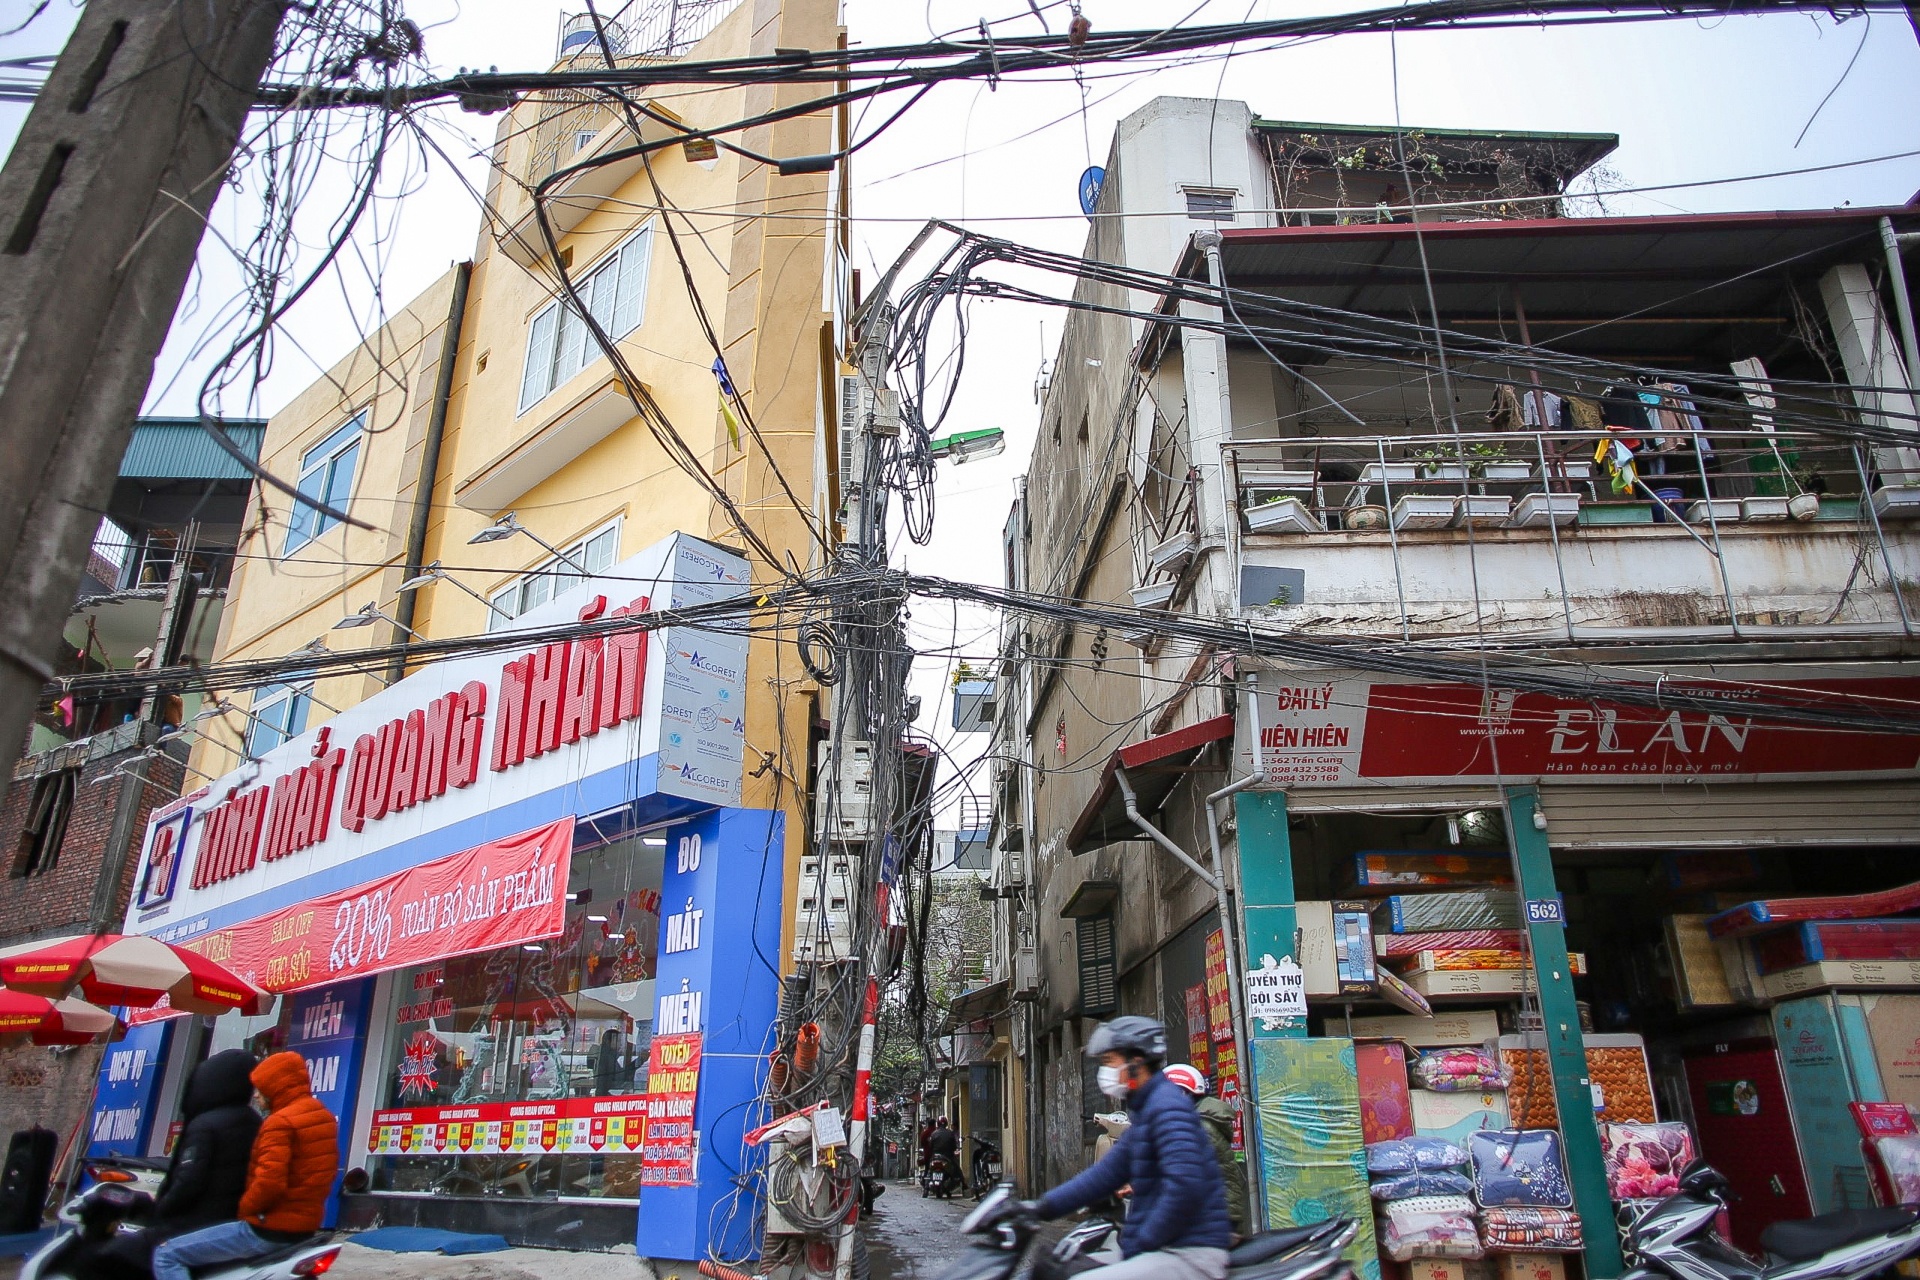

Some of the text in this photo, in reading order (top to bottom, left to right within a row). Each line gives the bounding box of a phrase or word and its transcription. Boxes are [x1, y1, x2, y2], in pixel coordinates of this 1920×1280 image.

[690, 650, 737, 678] ALCOREST
[1311, 682, 1333, 710] LÝ
[1302, 723, 1350, 747] HIÊN
[1460, 727, 1525, 735] www.elan.vn
[1546, 709, 1752, 754] ELAN
[340, 680, 487, 833] QUANG
[1313, 765, 1340, 773] 5588
[1316, 757, 1343, 765] Cung
[1581, 762, 1616, 771] hoan
[1623, 762, 1657, 771] chào
[1711, 761, 1739, 770] mới
[681, 762, 729, 788] ALCOREST
[1271, 775, 1295, 783] 0984
[1298, 774, 1317, 782] 379
[677, 833, 702, 874] ĐO
[329, 846, 556, 972] 20% TOÀN BỘ SẢN PHẨM
[1530, 904, 1558, 918] 562
[270, 911, 315, 945] SALE OFF
[665, 896, 704, 954] MẮT
[206, 930, 234, 962] YEAR
[289, 941, 311, 983] SỐC
[1280, 974, 1302, 989] THỢ
[658, 978, 702, 1036] MIỄN
[1250, 989, 1298, 1006] GỘI SẤY
[302, 990, 345, 1040] VIỄN
[660, 1037, 691, 1065] TUYỂN
[1715, 1044, 1729, 1052] FLY
[108, 1049, 148, 1088] DỊCH VỤ
[649, 1067, 698, 1094] NHÂN VIÊN
[112, 1100, 141, 1142] THUỐC
[648, 1097, 692, 1119] BÁN HÀNG
[662, 1122, 680, 1138] THEO
